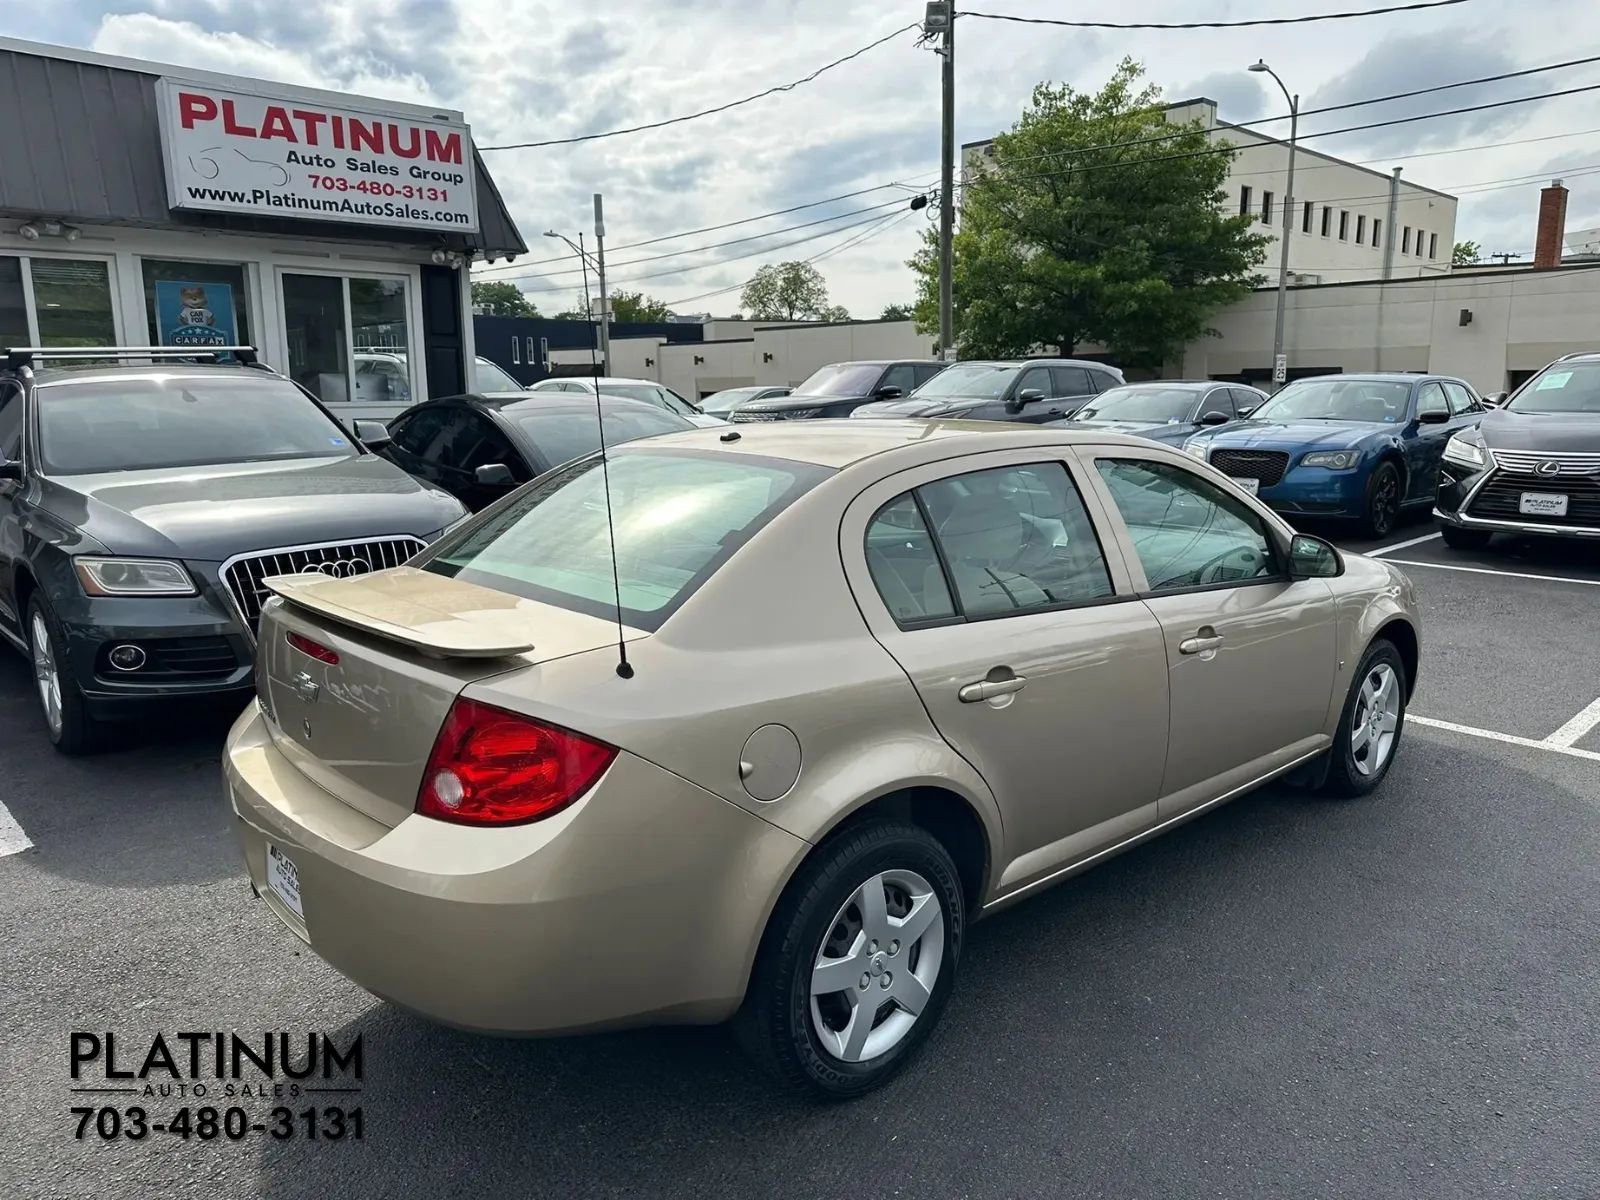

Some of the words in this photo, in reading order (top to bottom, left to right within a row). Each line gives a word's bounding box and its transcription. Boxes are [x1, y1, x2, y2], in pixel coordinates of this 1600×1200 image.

[178, 92, 463, 165] PLATINUM
[286, 150, 336, 170] Auto
[346, 157, 400, 177] Sales
[409, 166, 464, 186] Group
[307, 174, 449, 203] 703-480-3131
[187, 186, 469, 225] www.PlatinumAutoSales.com
[175, 336, 224, 345] CARFAX
[1276, 368, 1285, 379] 25
